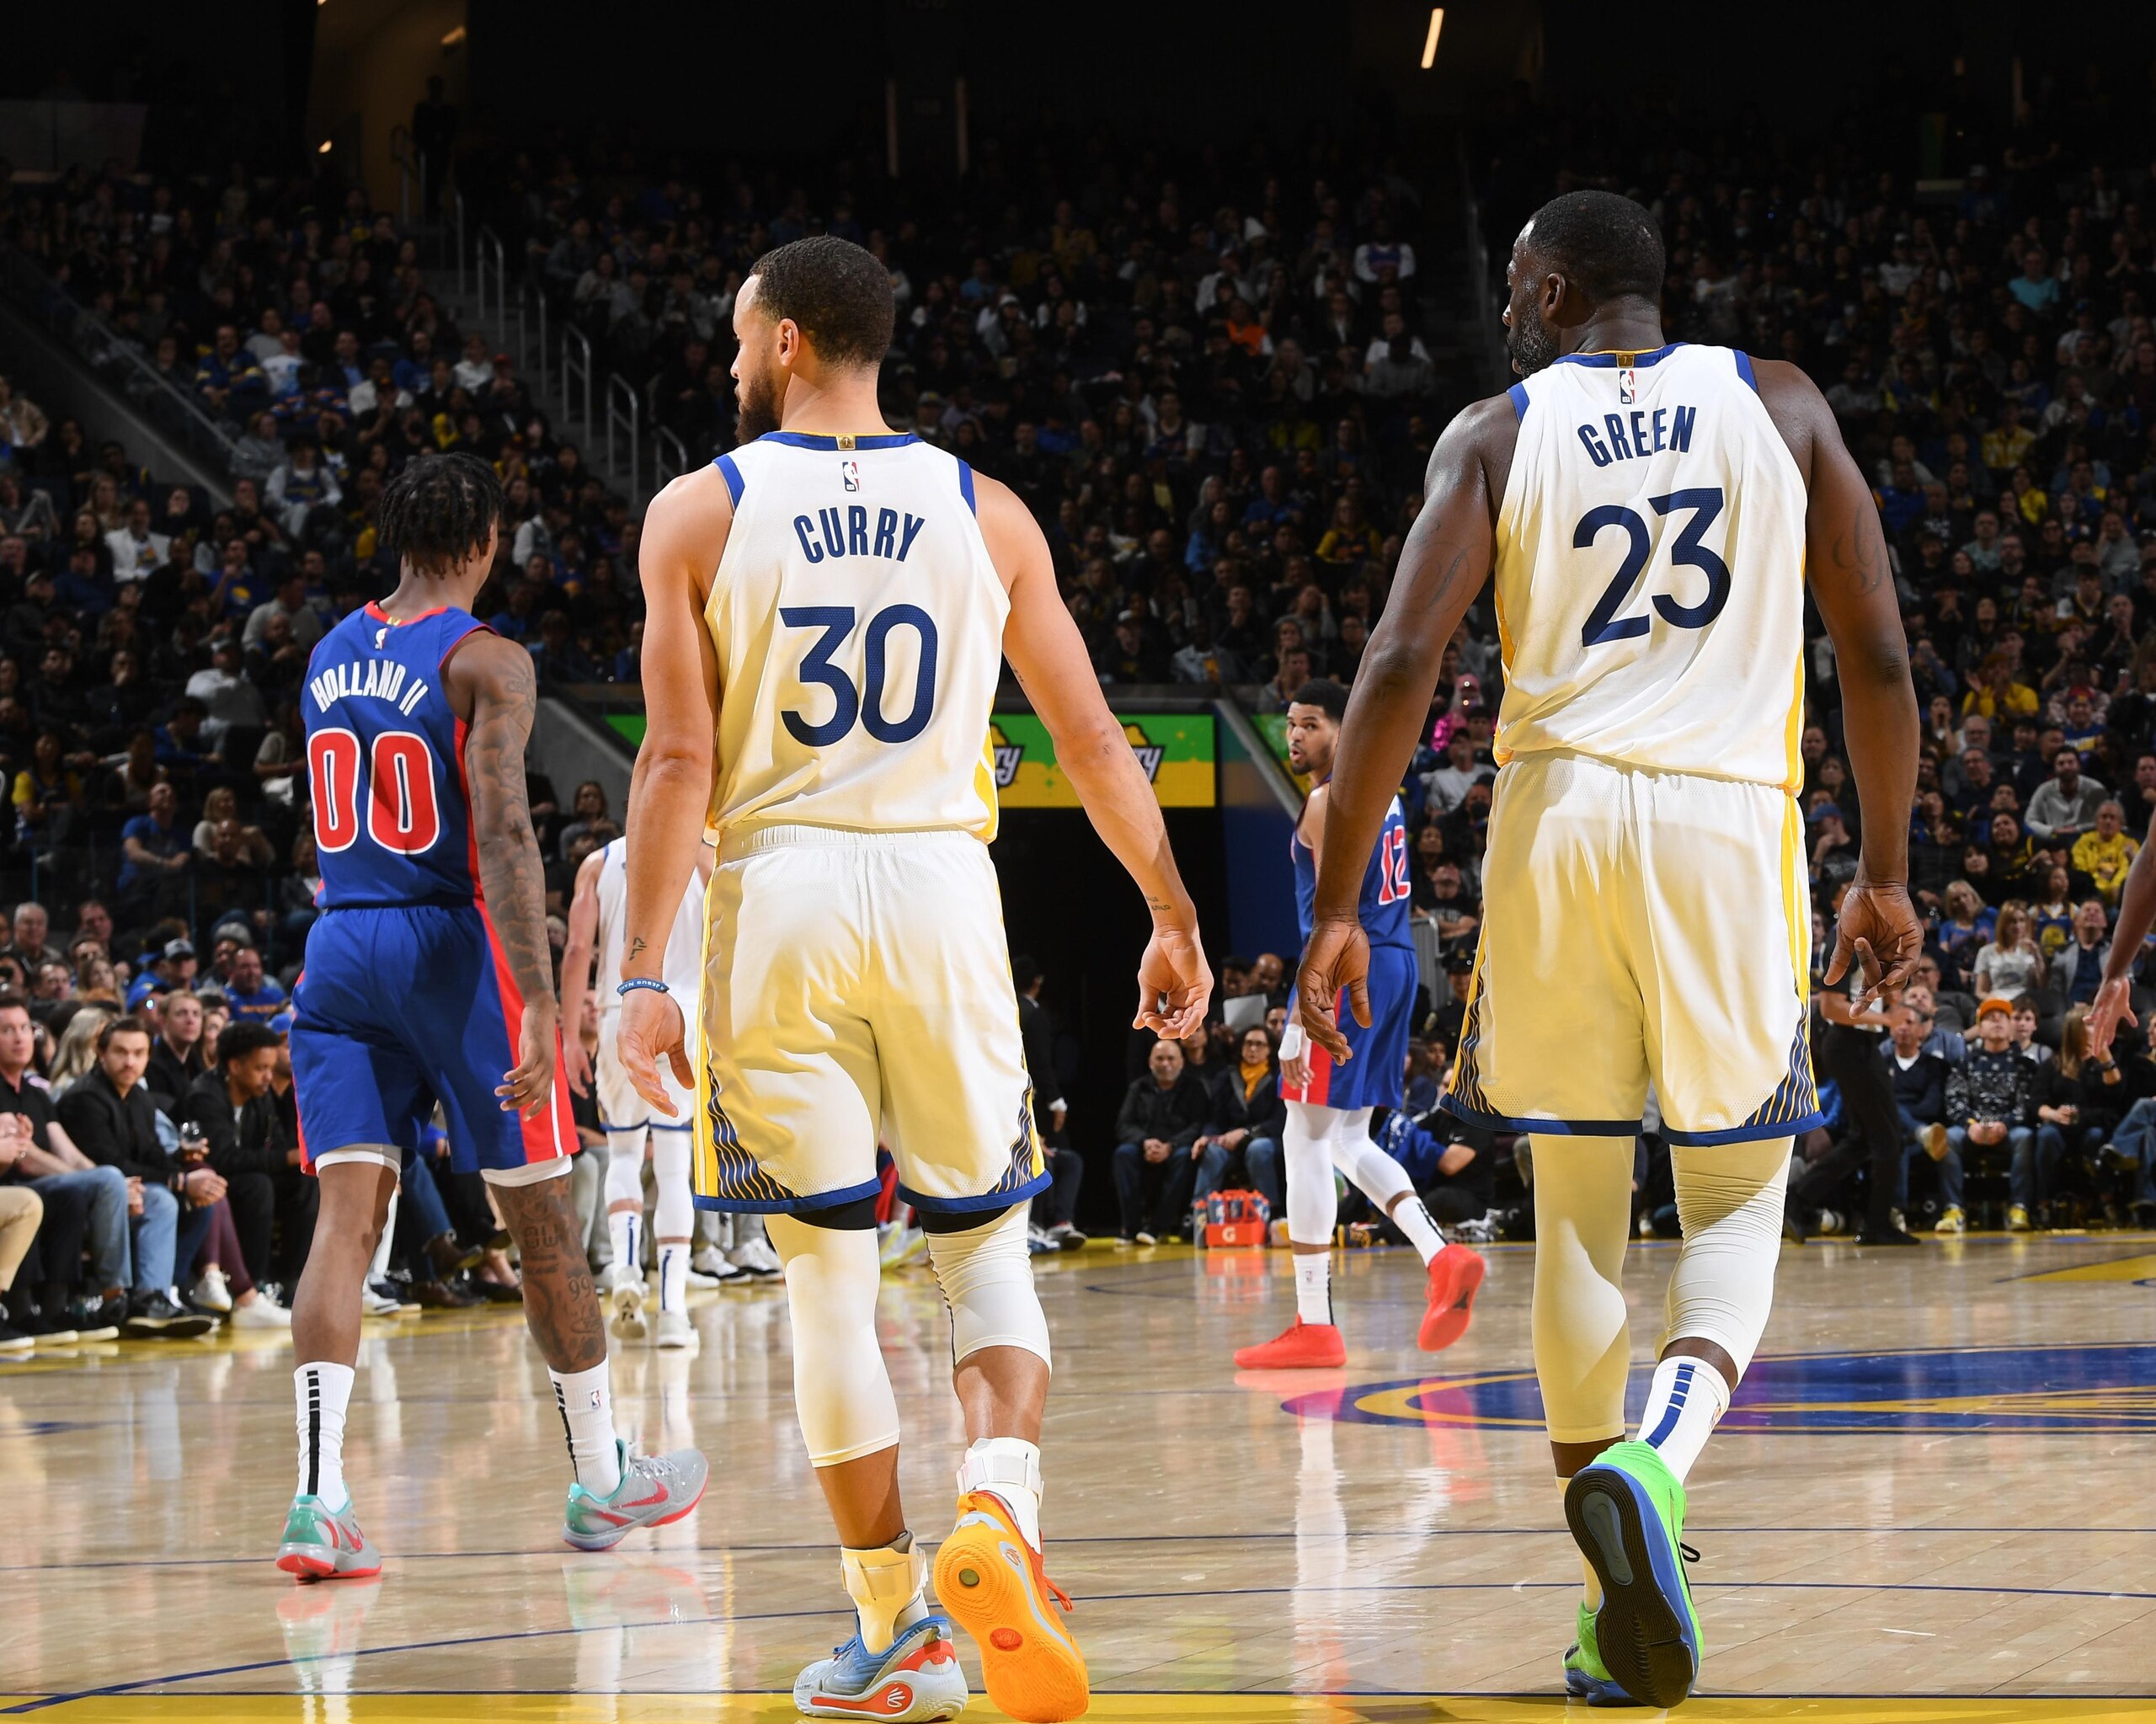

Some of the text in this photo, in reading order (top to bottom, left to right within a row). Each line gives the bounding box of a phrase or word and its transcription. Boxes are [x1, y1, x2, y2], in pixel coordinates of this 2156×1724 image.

[1577, 405, 1697, 467] GREEN
[792, 504, 926, 564] CURRY
[1572, 487, 1732, 648] 23
[309, 659, 429, 717] HOLLAND II
[778, 603, 938, 747] 30
[307, 727, 440, 856] 00
[1378, 825, 1412, 906] 12
[1221, 1226, 1236, 1243] G
